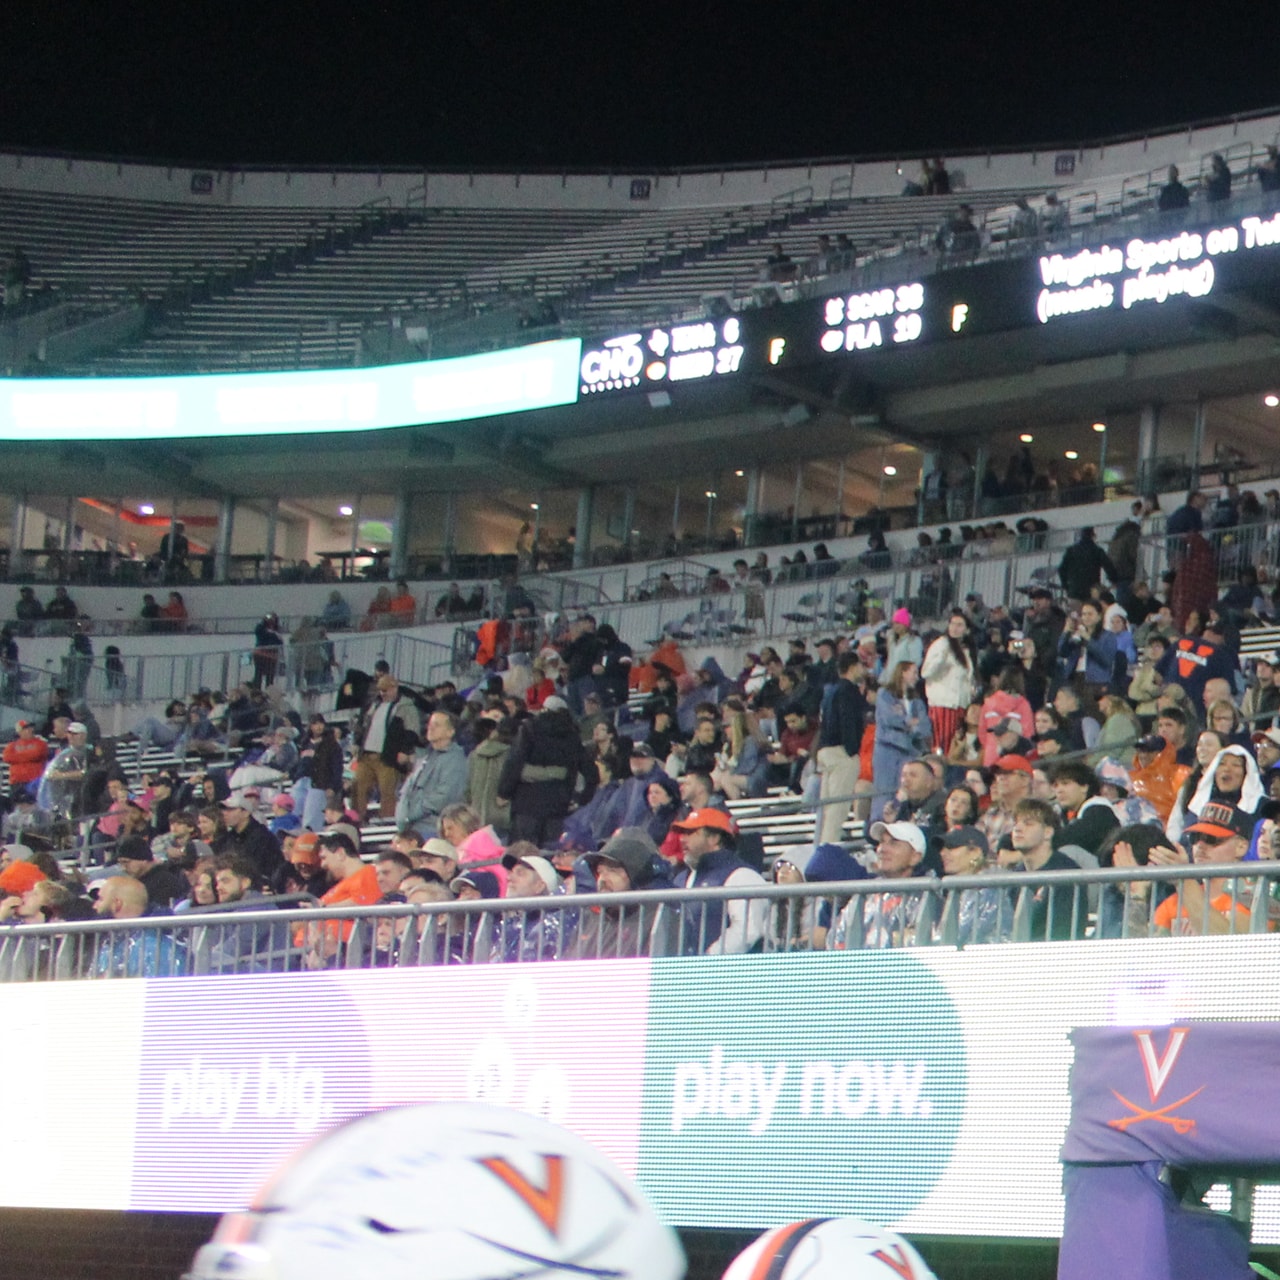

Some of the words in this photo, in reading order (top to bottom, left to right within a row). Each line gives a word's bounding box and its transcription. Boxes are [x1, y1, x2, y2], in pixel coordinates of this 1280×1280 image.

[1040, 247, 1123, 285] Virginia
[1126, 230, 1203, 276] Sports
[1206, 223, 1237, 255] on
[1036, 280, 1114, 323] (music
[1122, 260, 1215, 308] playing)
[845, 321, 882, 350] FLA
[951, 304, 968, 332] F
[581, 346, 643, 384] CHO
[768, 338, 785, 365] F
[160, 1058, 242, 1130] play
[670, 1045, 784, 1131] play
[797, 1058, 937, 1117] now.
